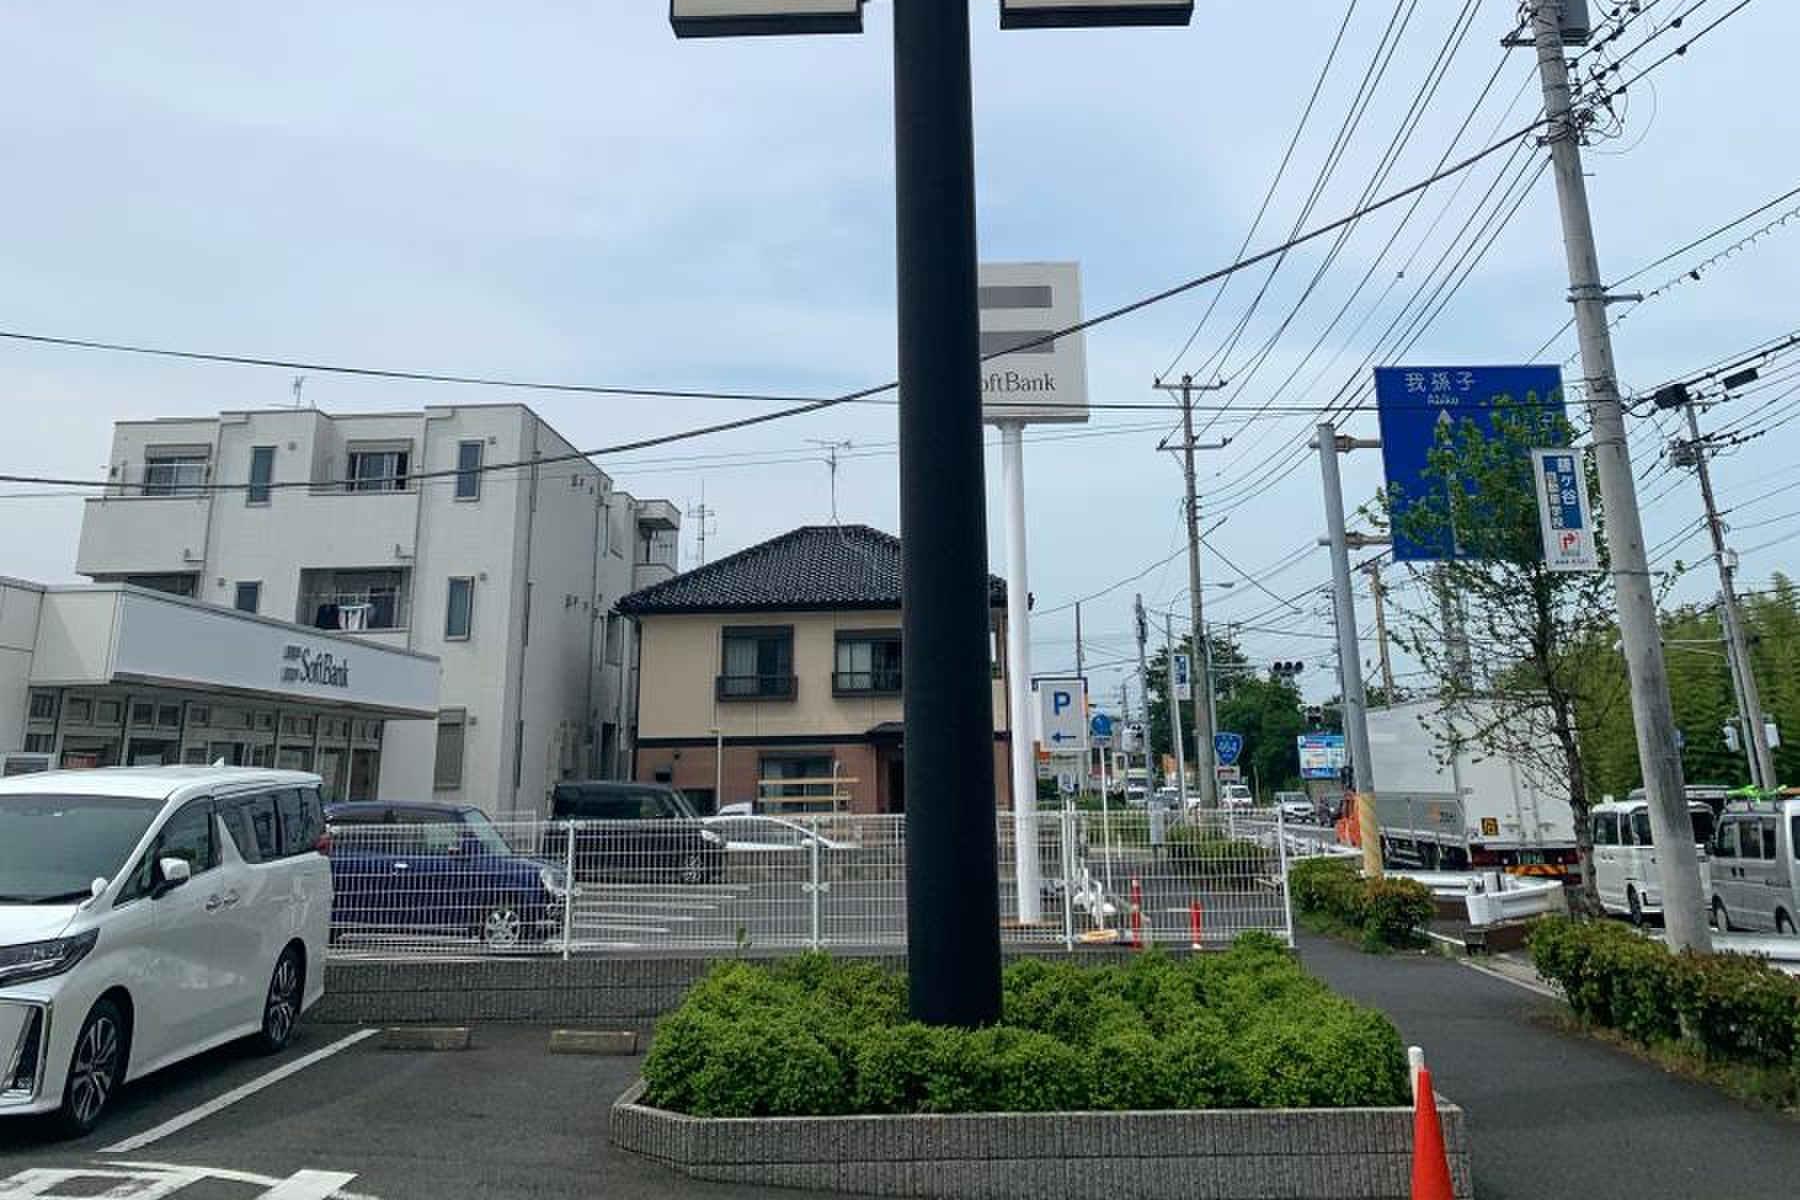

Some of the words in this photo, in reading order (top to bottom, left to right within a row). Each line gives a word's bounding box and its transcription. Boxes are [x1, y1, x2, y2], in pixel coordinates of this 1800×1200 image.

[981, 371, 1057, 392] oftBank
[1405, 371, 1474, 393] 我孫子
[301, 647, 349, 688] SoftBank
[1053, 691, 1071, 716] P
